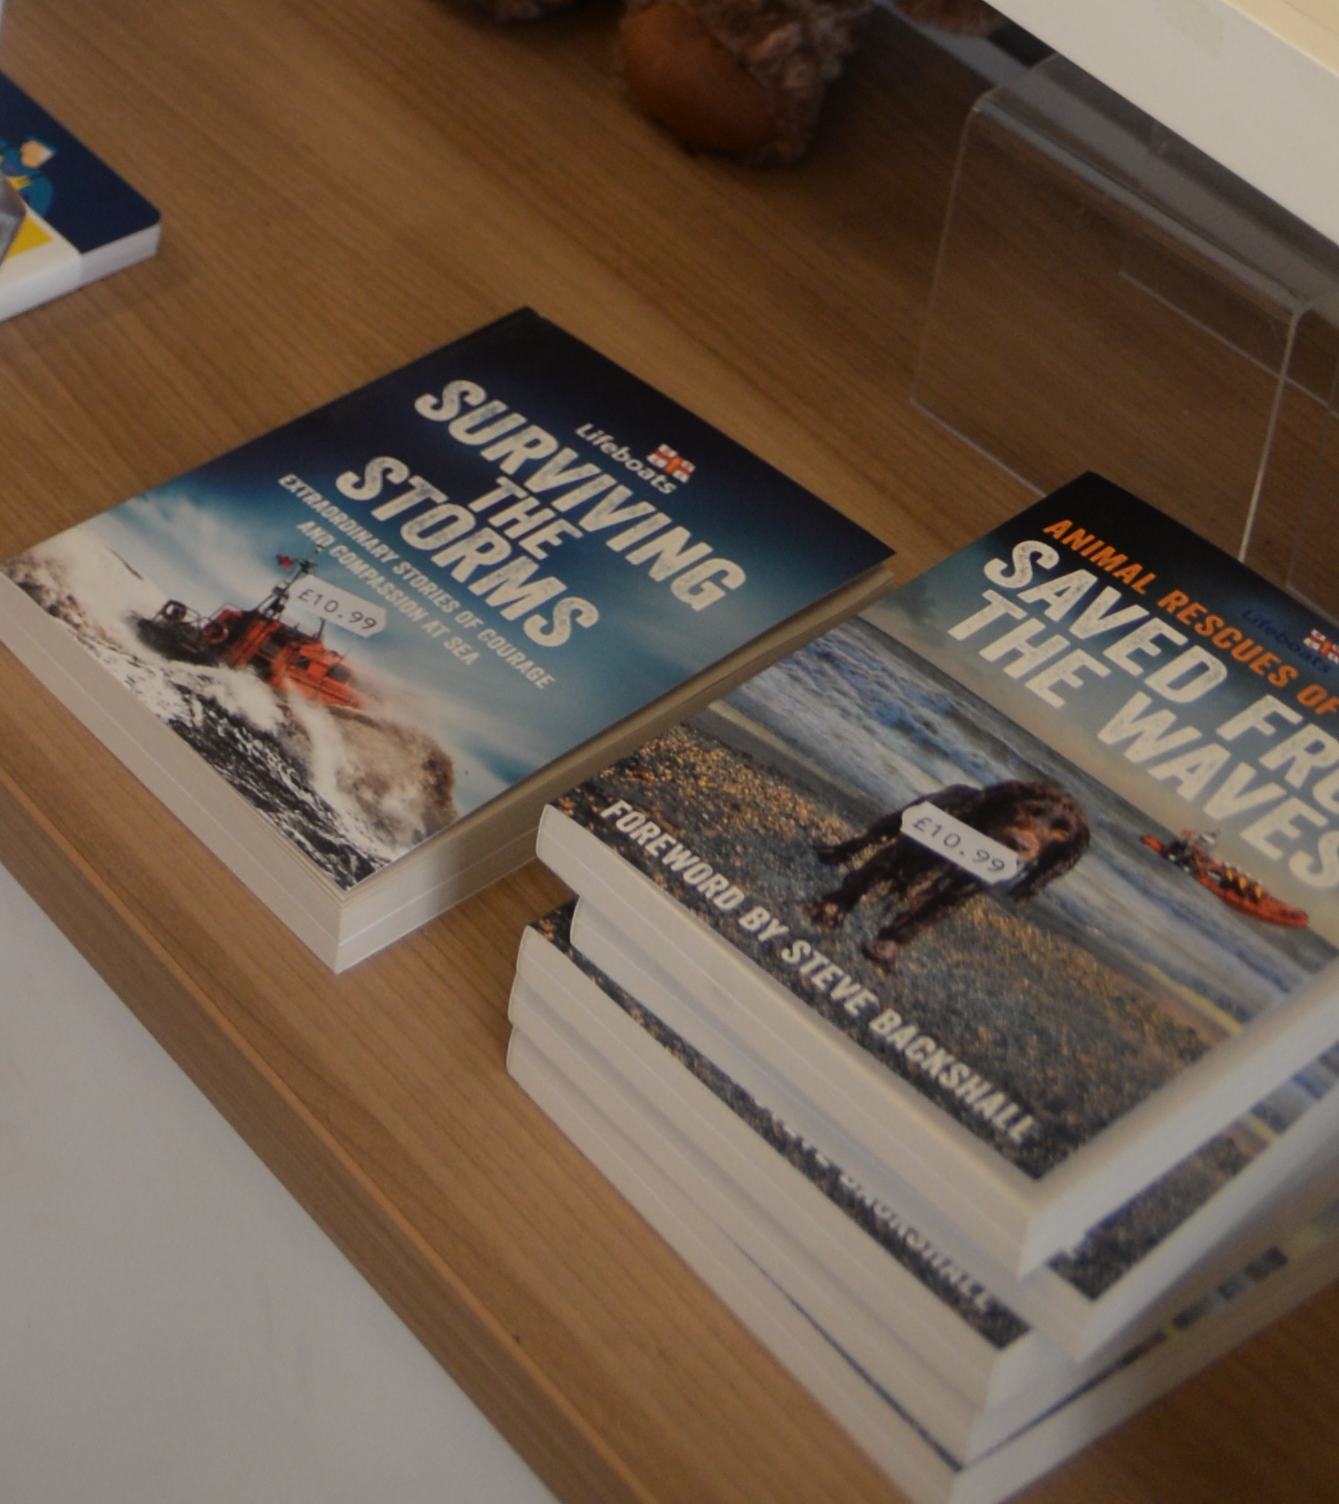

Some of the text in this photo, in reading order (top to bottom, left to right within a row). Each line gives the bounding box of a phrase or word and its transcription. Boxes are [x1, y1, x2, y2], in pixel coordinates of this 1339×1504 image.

[413, 378, 747, 612] SURVIVING
[468, 476, 583, 561] THE
[574, 421, 678, 496] Lifeboats
[278, 473, 556, 689] EXTRAORDINARY STORIES OF COURAGE
[296, 520, 481, 665] AND COMPASSION AT SEA
[297, 588, 379, 631] £10.99
[335, 455, 599, 649] STORMS
[984, 540, 1228, 704] SAVED
[1042, 518, 1339, 715] ANIMAL RESCUES OF
[1241, 606, 1332, 674] Lifeboats
[947, 591, 1339, 889] THE WAVES
[910, 815, 1008, 877] £10.99
[600, 800, 1039, 1146] FOREWORD BY STEVE BACKSHALL
